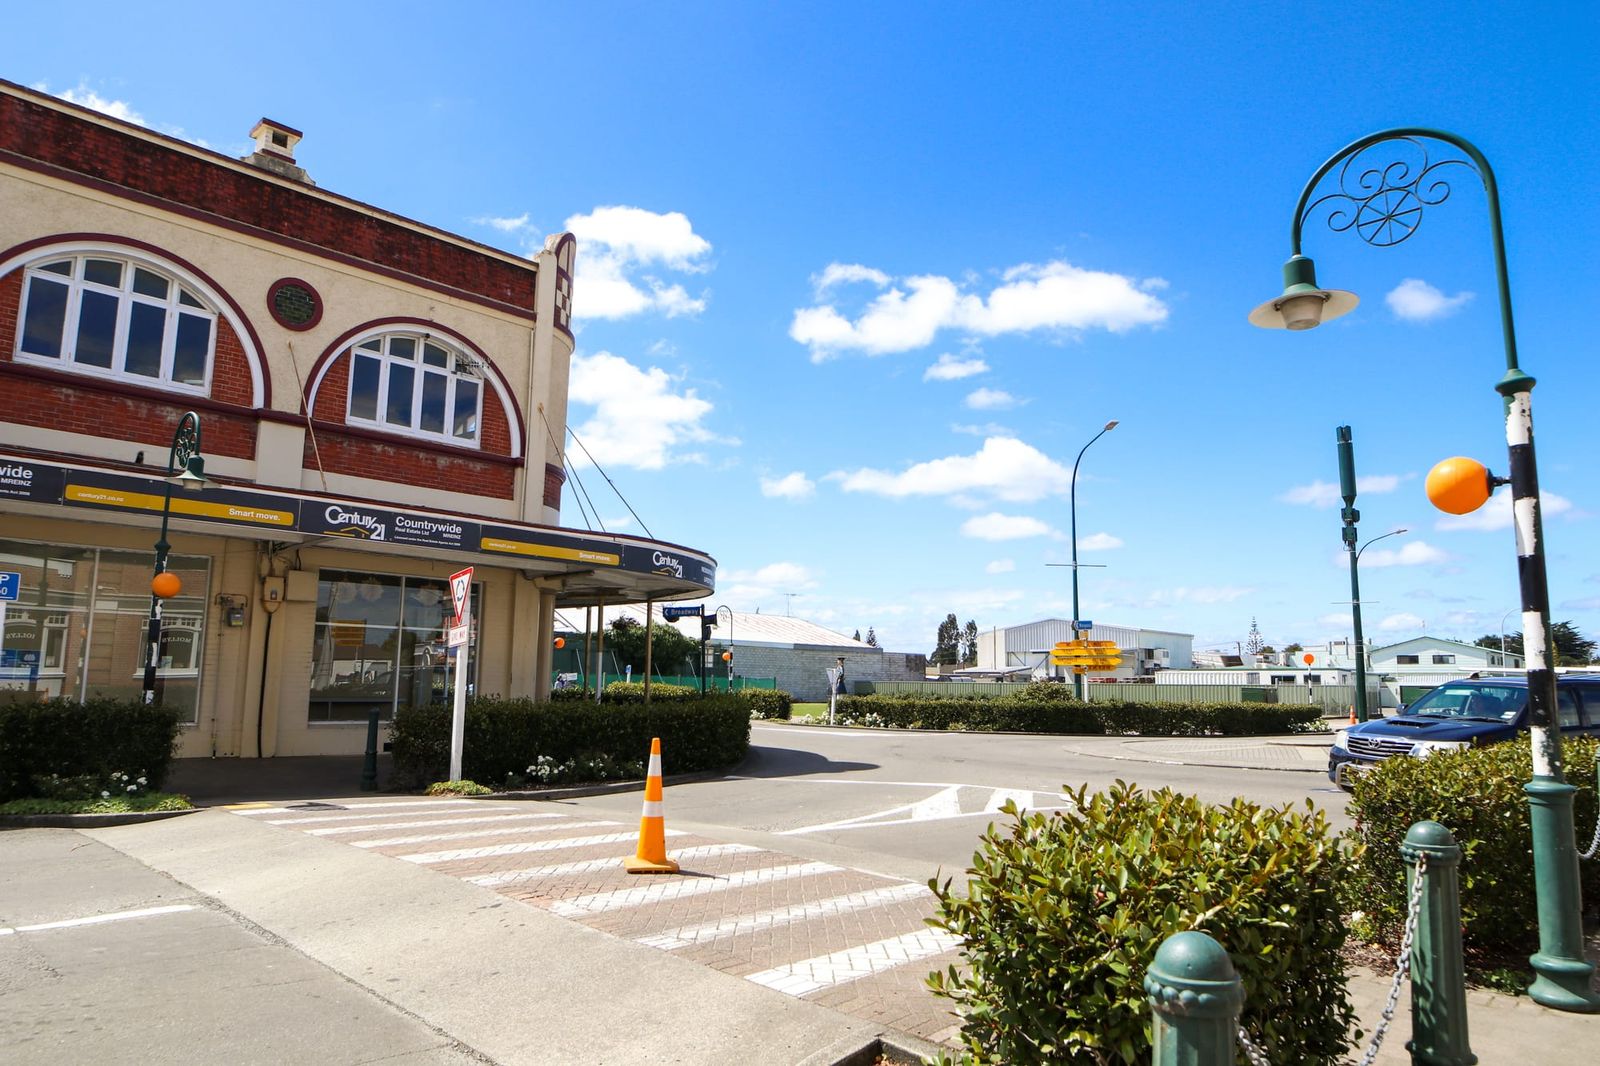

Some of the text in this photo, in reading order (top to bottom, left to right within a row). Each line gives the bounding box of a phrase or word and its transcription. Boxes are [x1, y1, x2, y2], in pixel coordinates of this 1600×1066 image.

[229, 508, 281, 521] Smart move.
[325, 505, 386, 540] Century 21
[395, 516, 462, 534] Countrywide
[653, 551, 680, 569] Century
[675, 565, 683, 578] 21
